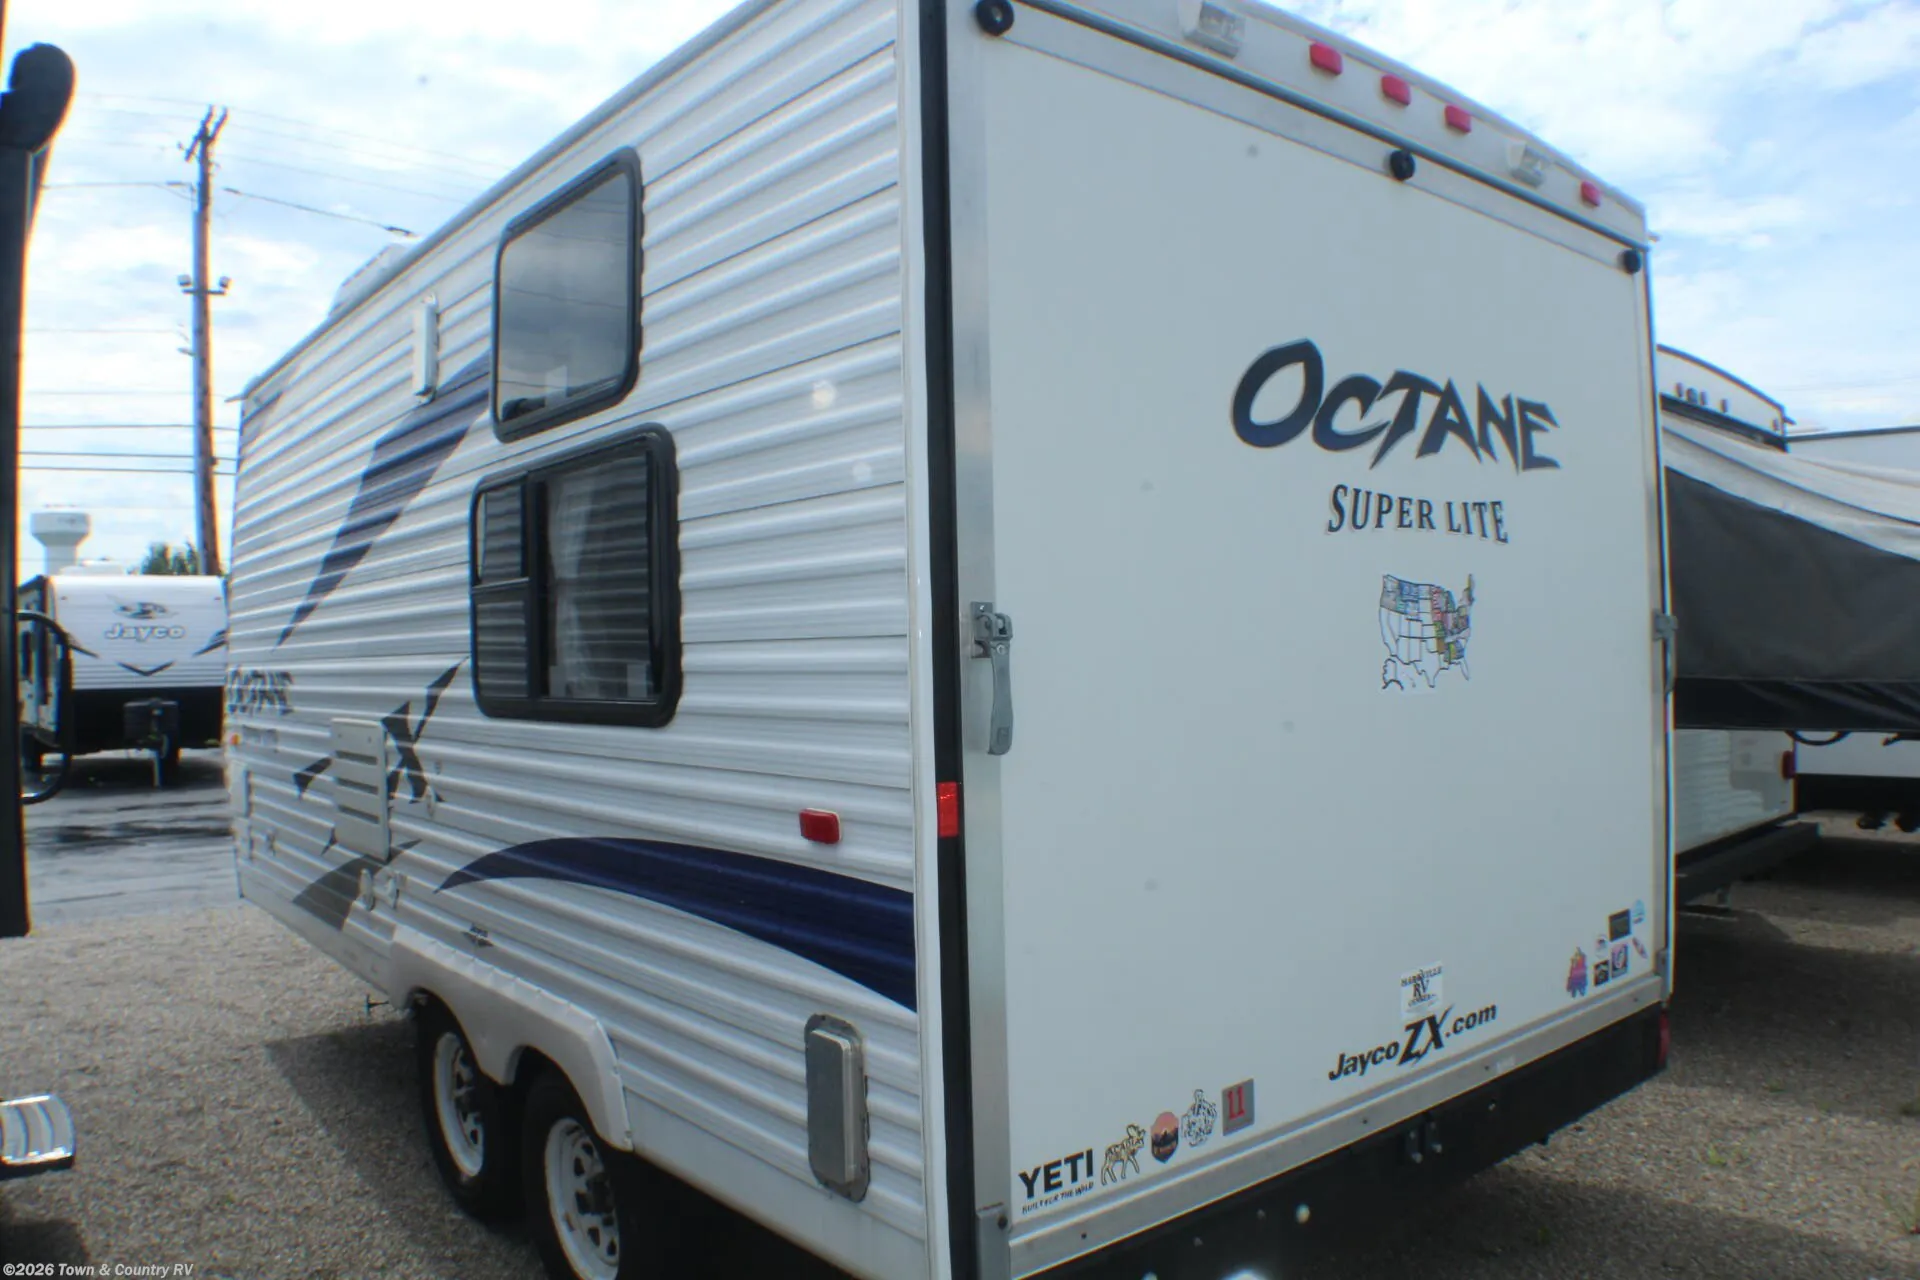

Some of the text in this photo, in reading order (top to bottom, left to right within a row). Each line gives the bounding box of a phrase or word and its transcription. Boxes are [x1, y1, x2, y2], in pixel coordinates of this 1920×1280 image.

[1231, 338, 1560, 475] OCTANE
[1326, 483, 1509, 544] SUPER LITE
[104, 622, 186, 643] Jayco
[1018, 1148, 1094, 1199] YETI
